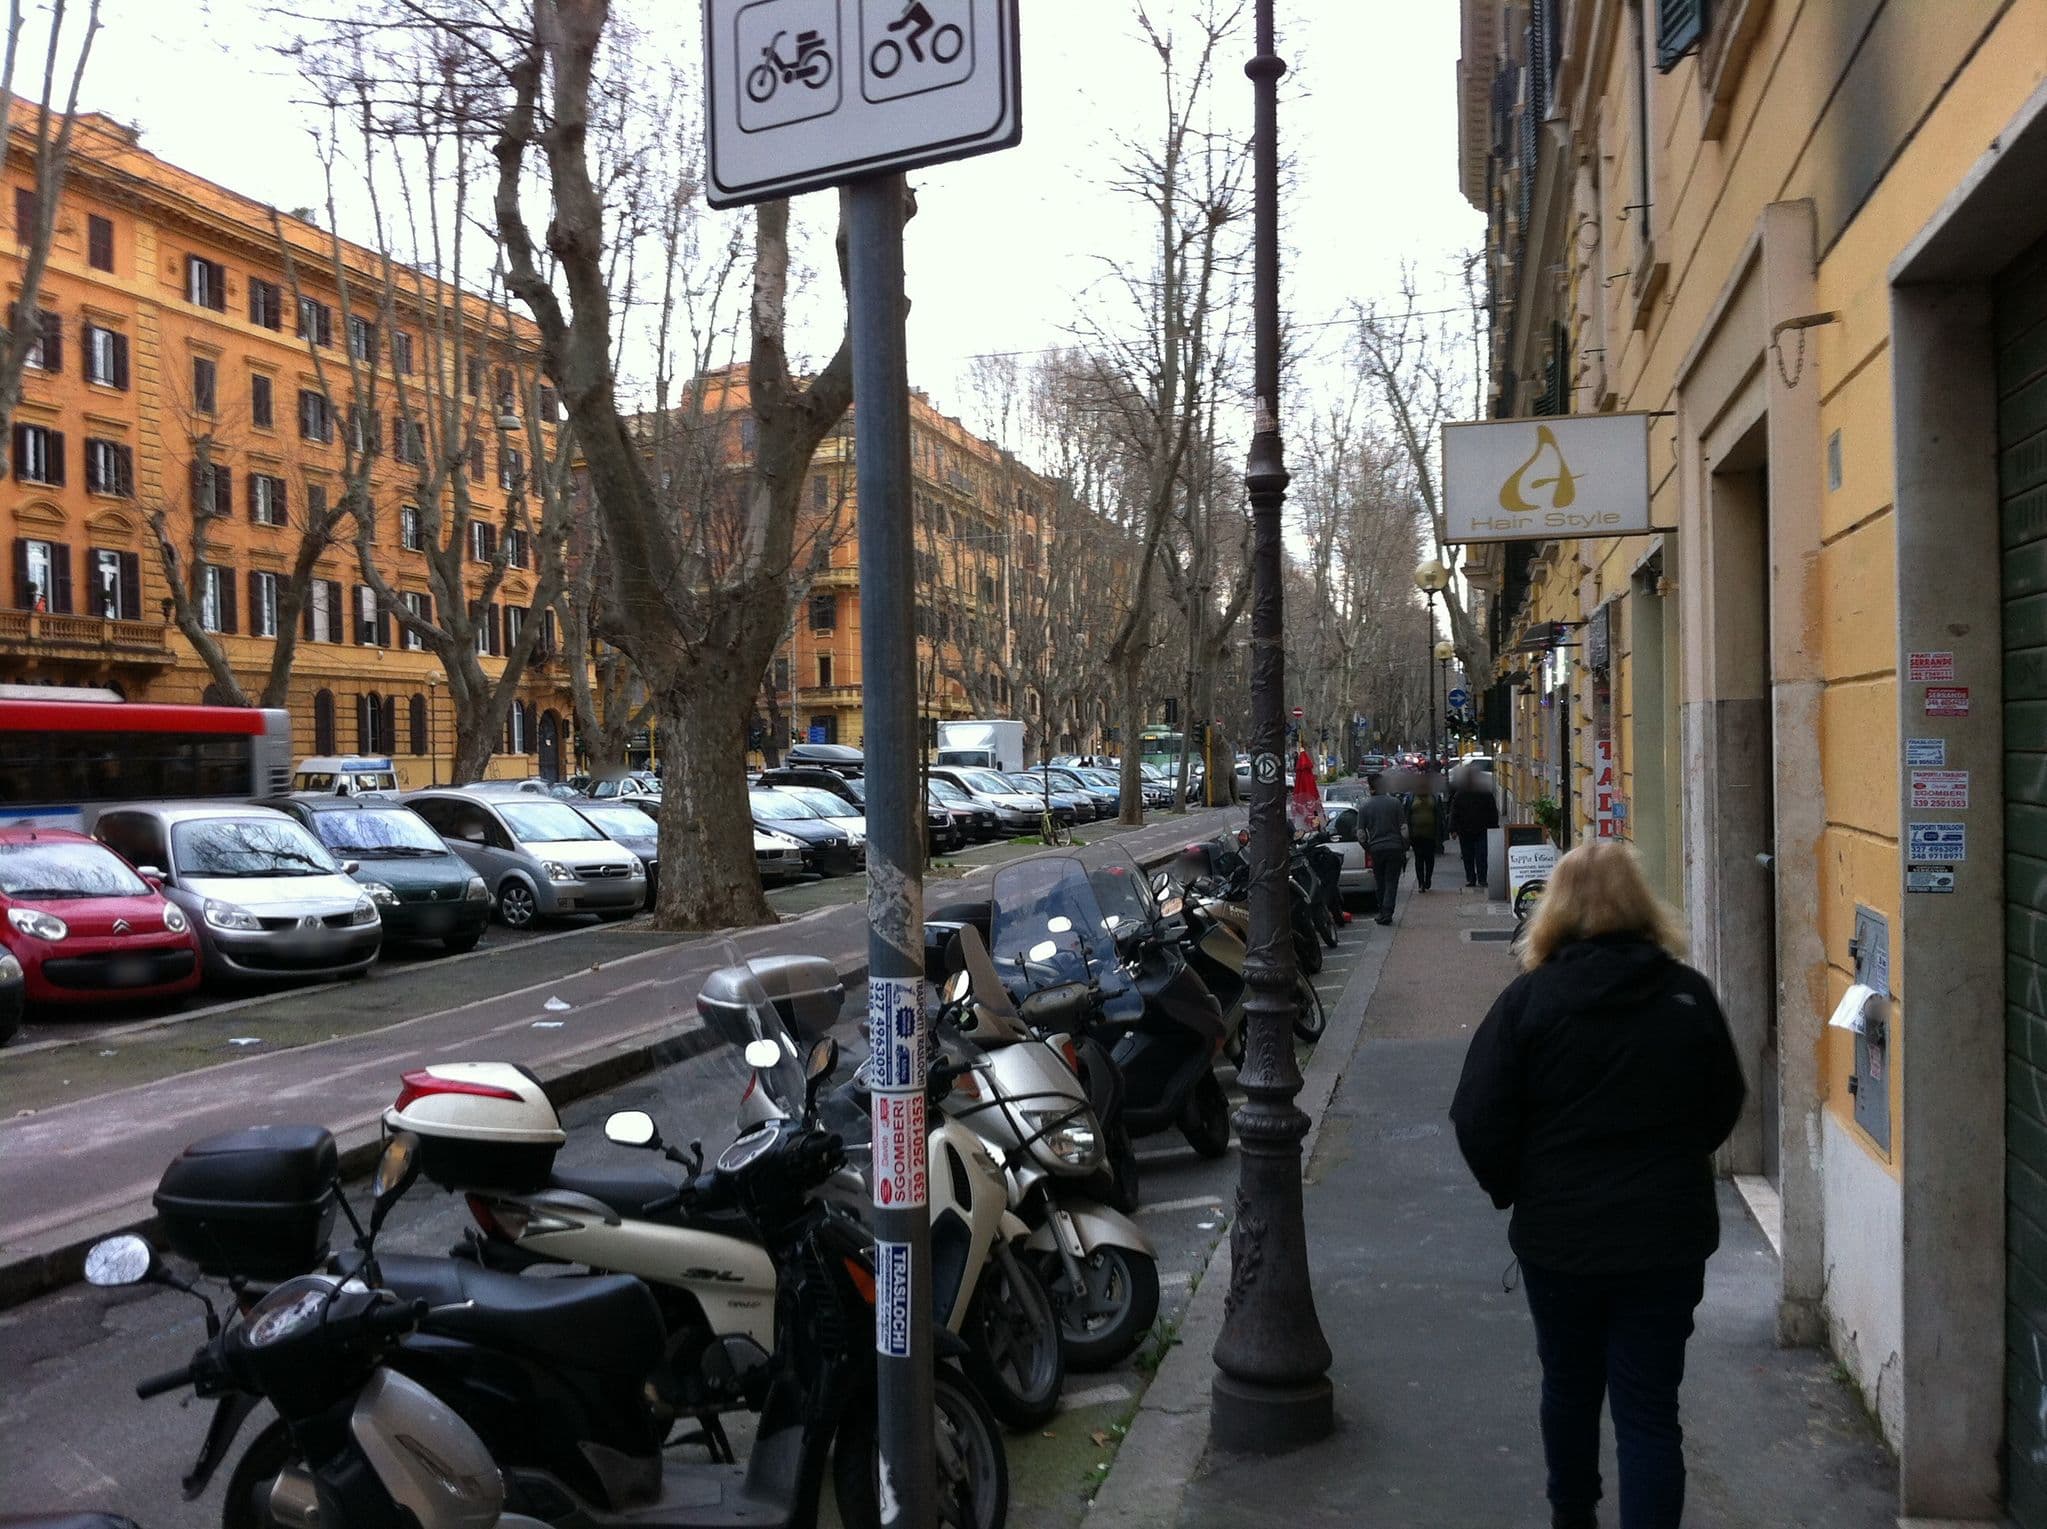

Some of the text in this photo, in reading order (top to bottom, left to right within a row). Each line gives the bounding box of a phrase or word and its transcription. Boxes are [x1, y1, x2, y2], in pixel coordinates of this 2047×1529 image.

[1470, 511, 1621, 531] Hair Style
[875, 982, 885, 1088] 327 4963097
[916, 979, 925, 1088] TRASPORTI TRASLOCHI
[893, 1100, 906, 1203] SGOMBERI
[912, 1096, 925, 1202] 339 2501353
[892, 1250, 906, 1350] TRASLOCHI
